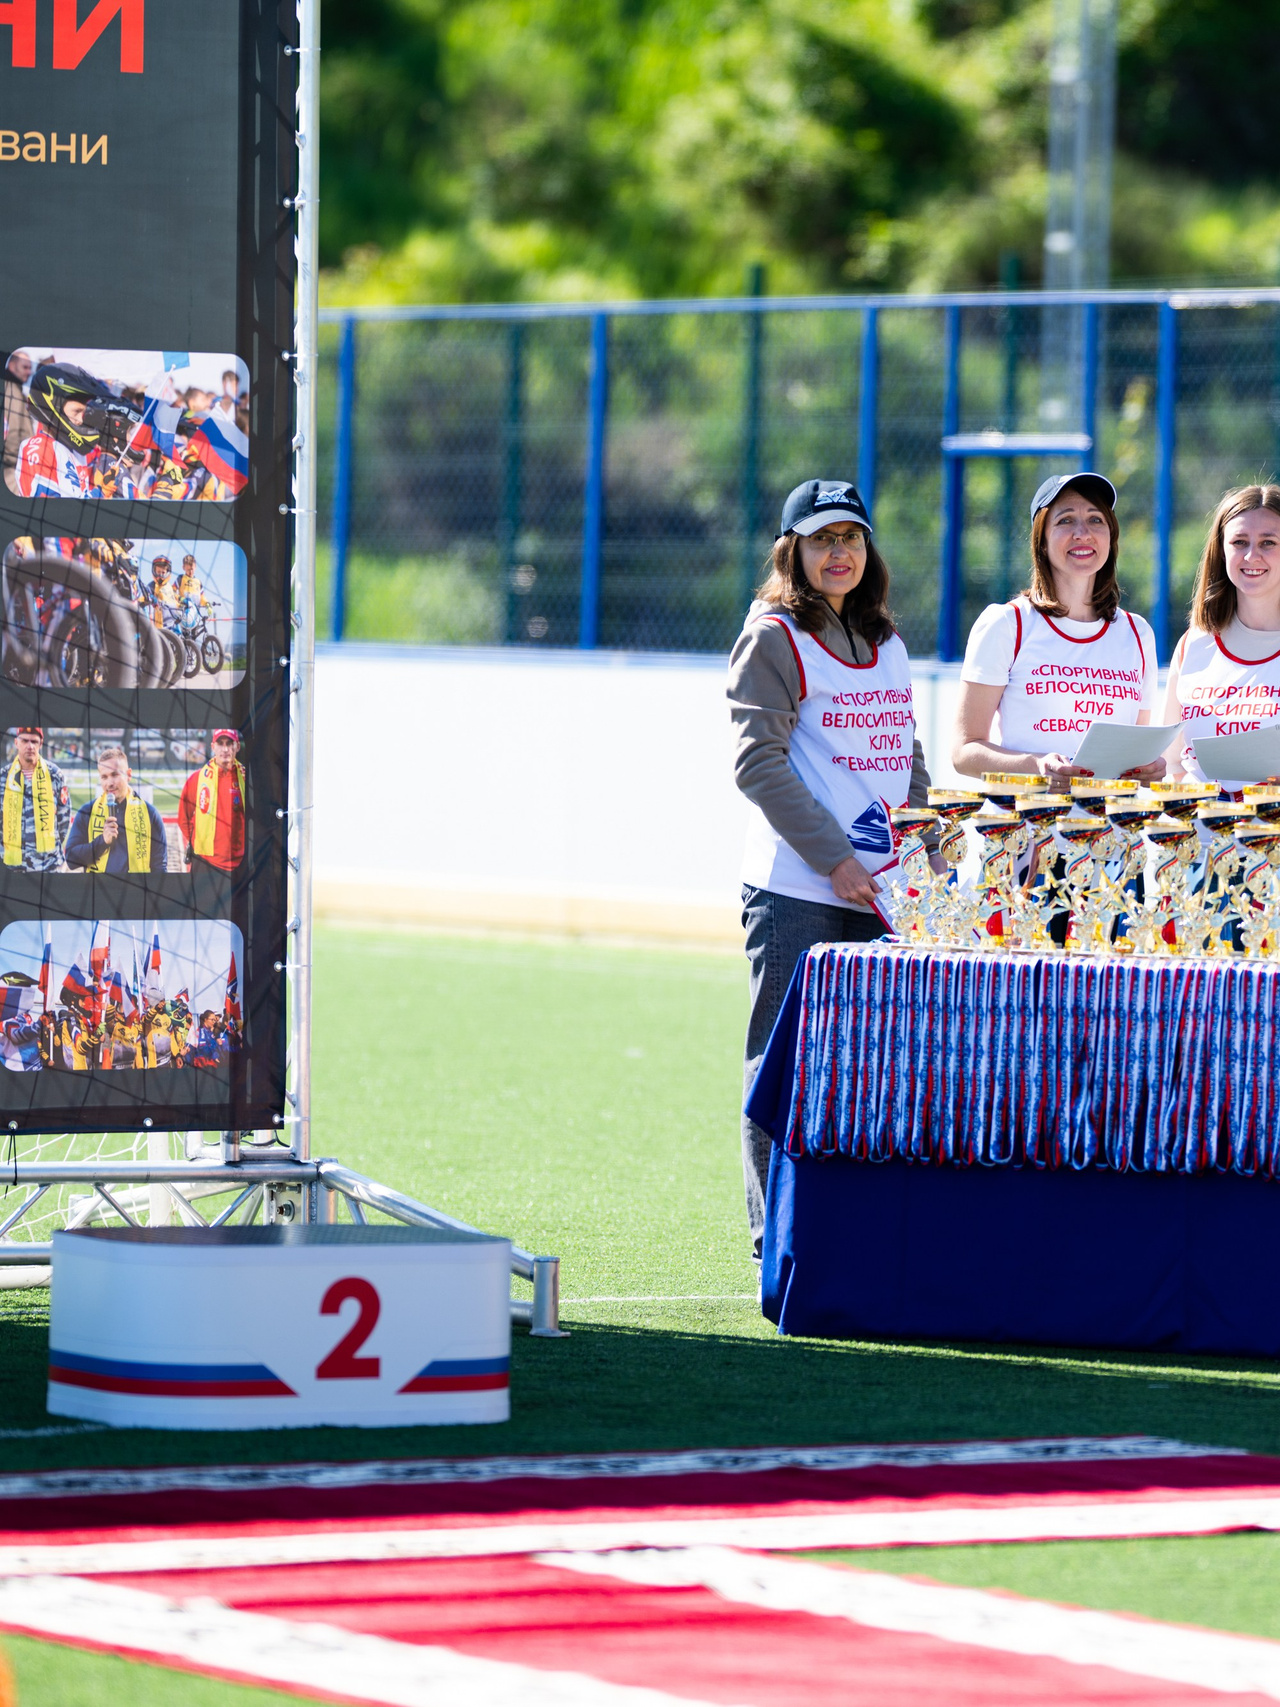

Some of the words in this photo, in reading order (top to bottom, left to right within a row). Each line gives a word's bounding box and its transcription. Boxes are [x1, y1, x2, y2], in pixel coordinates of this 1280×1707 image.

[1025, 681, 1142, 702] ВЕЛОСИПЕДНЫ
[1074, 700, 1114, 716] КЛУБ
[822, 710, 914, 728] ВЕЛОСИПЕДН
[869, 733, 902, 750] КЛУБ
[36, 766, 49, 831] МИЛЛЕ
[315, 1276, 381, 1380] 2
